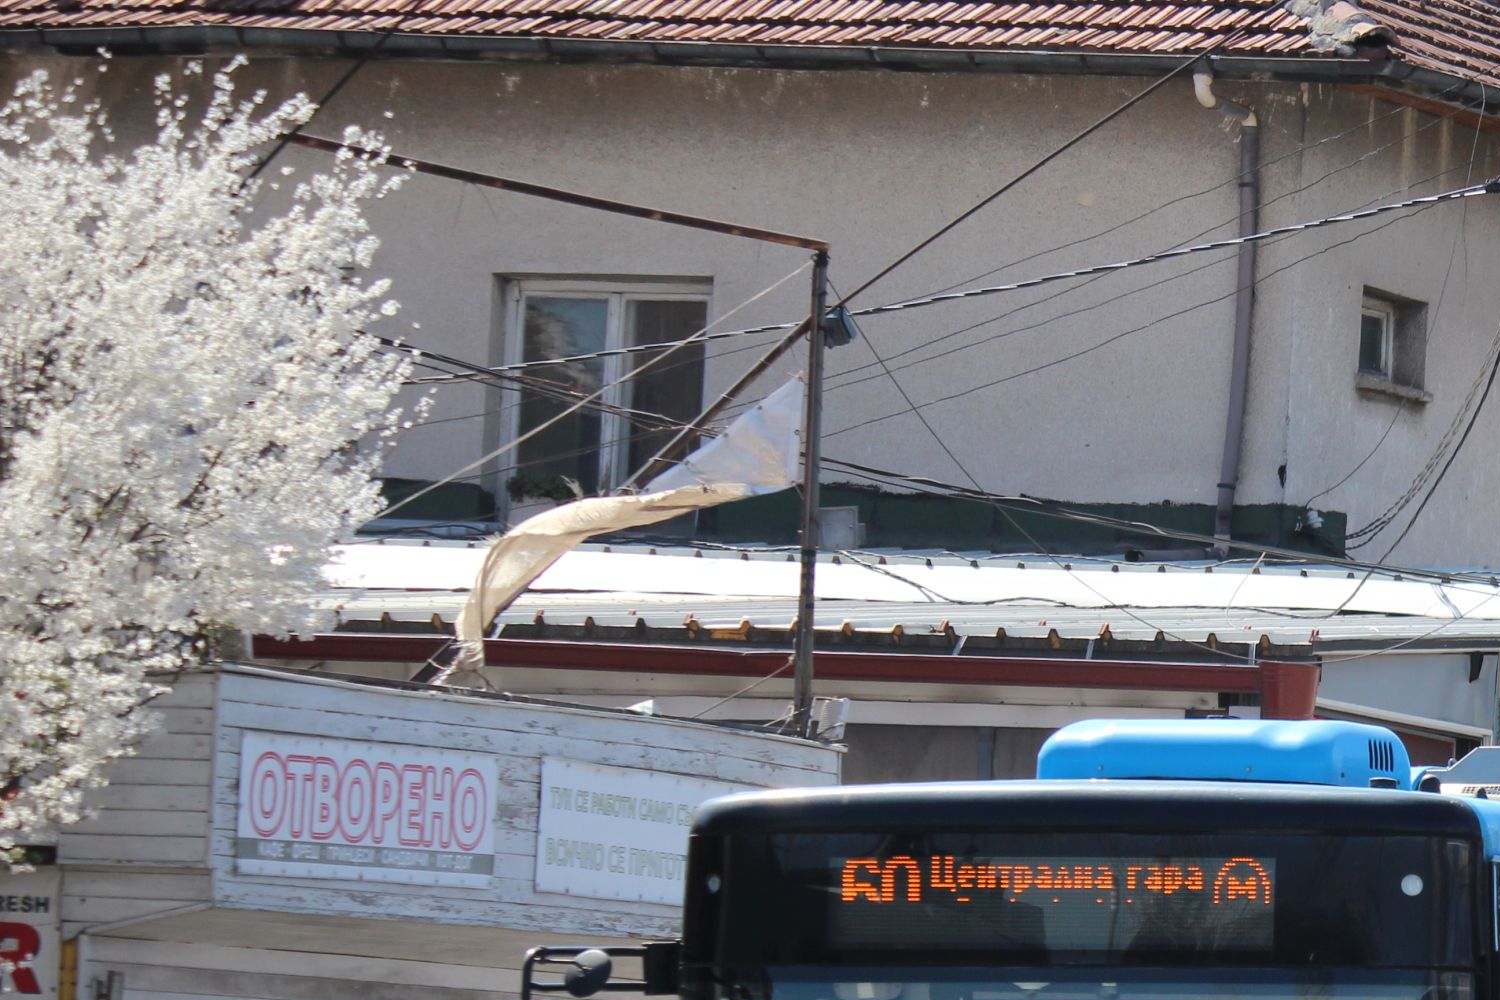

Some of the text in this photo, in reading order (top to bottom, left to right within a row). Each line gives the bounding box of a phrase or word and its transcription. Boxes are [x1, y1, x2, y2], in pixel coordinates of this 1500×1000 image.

[250, 751, 487, 851] ОТВОРЕНО
[550, 786, 573, 810] ТУК
[575, 790, 590, 813] СЕ
[591, 792, 637, 820] РАБОТИ
[639, 799, 674, 825] САМО
[545, 838, 605, 872] ВСИЧКО
[607, 845, 626, 874] СЕ
[931, 856, 1112, 892] Централна
[1127, 866, 1203, 893] гара
[0, 896, 49, 913] ESH
